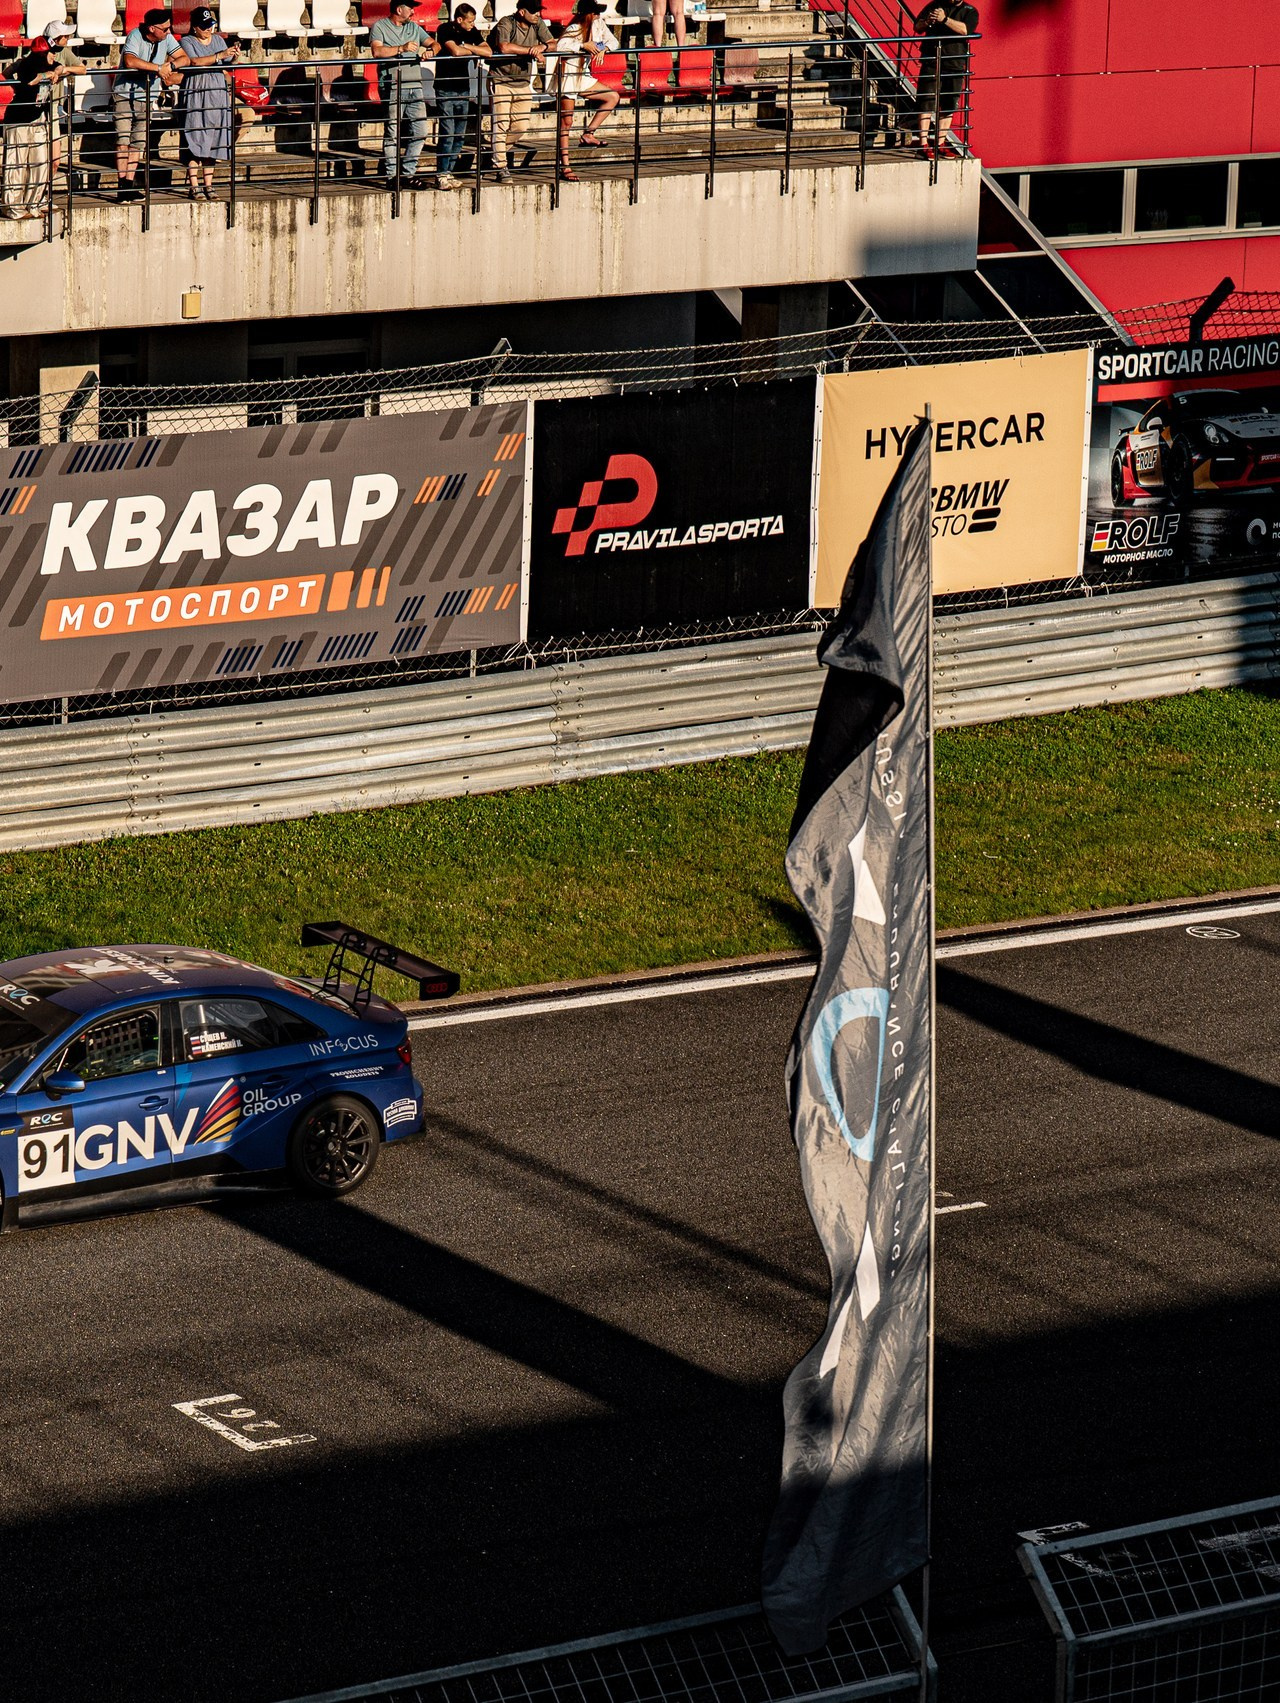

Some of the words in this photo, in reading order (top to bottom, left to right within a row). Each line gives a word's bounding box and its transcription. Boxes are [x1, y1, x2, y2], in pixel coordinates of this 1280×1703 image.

[1098, 349, 1204, 381] SPORTCAR
[1208, 341, 1280, 372] RACING
[865, 412, 1045, 460] HYERCAR
[40, 472, 399, 575] КВАЗАР
[594, 514, 785, 554] PRAVILASPORTA
[1108, 513, 1180, 550] ROLF
[1103, 553, 1146, 565] МОТОРНОЕ
[1146, 548, 1174, 559] МАСЛО
[57, 579, 318, 633] МОТОСПОРТ
[242, 1093, 302, 1117] GROUP
[243, 1088, 269, 1104] OIL
[23, 1134, 70, 1179] 91
[75, 1107, 199, 1170] GNV
